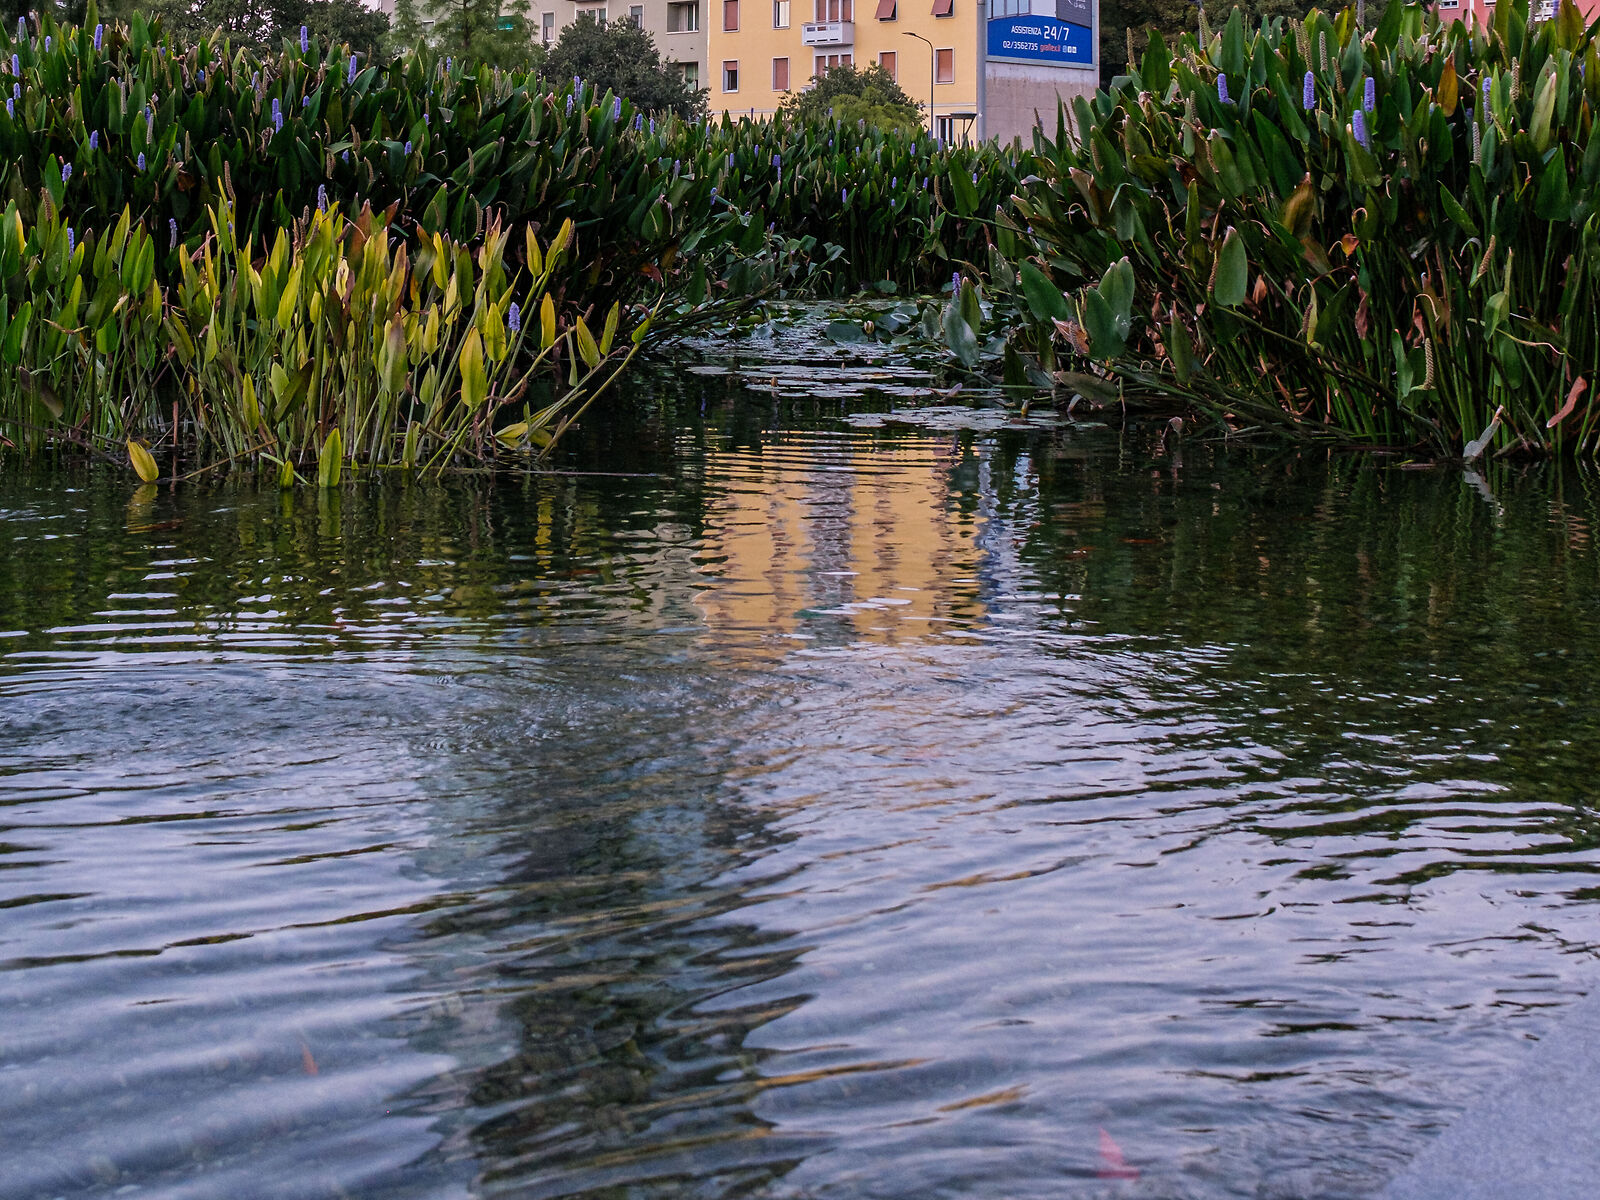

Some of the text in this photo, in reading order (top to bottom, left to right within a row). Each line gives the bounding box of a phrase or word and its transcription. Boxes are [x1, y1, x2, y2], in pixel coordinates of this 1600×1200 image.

[1010, 25, 1070, 41] ASSISTENZA 24/7
[1002, 40, 1039, 51] 02/3562735
